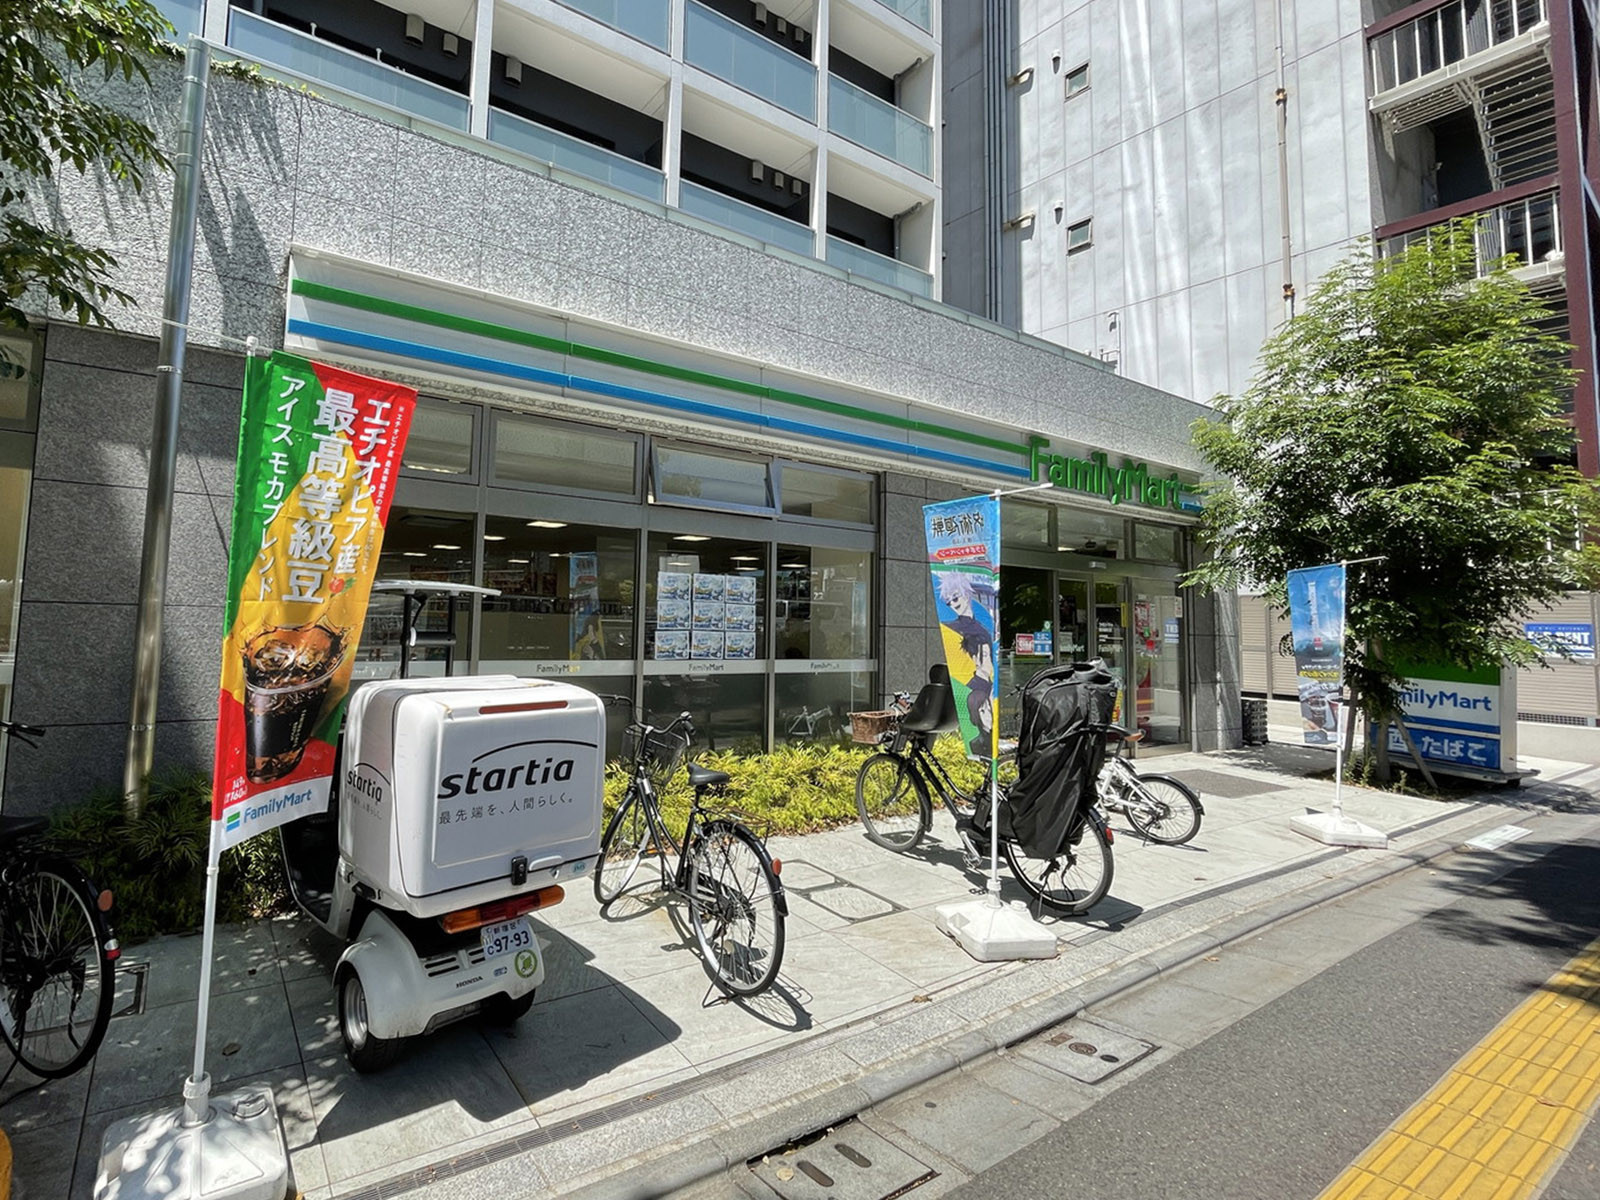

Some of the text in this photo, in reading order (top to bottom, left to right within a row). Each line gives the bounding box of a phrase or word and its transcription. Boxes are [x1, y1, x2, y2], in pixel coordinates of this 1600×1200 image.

[333, 399, 391, 575] エチオピア産
[1029, 434, 1183, 510] FamilyMart
[281, 387, 358, 604] 最高等級豆
[689, 664, 724, 673] FamilyMart
[1399, 688, 1492, 712] milyMart
[1421, 735, 1487, 762] たばこ
[347, 769, 383, 802] startia
[437, 757, 574, 799] startia
[243, 789, 312, 824] FamilyMart
[439, 792, 573, 825] 最先端を、人間らしく。
